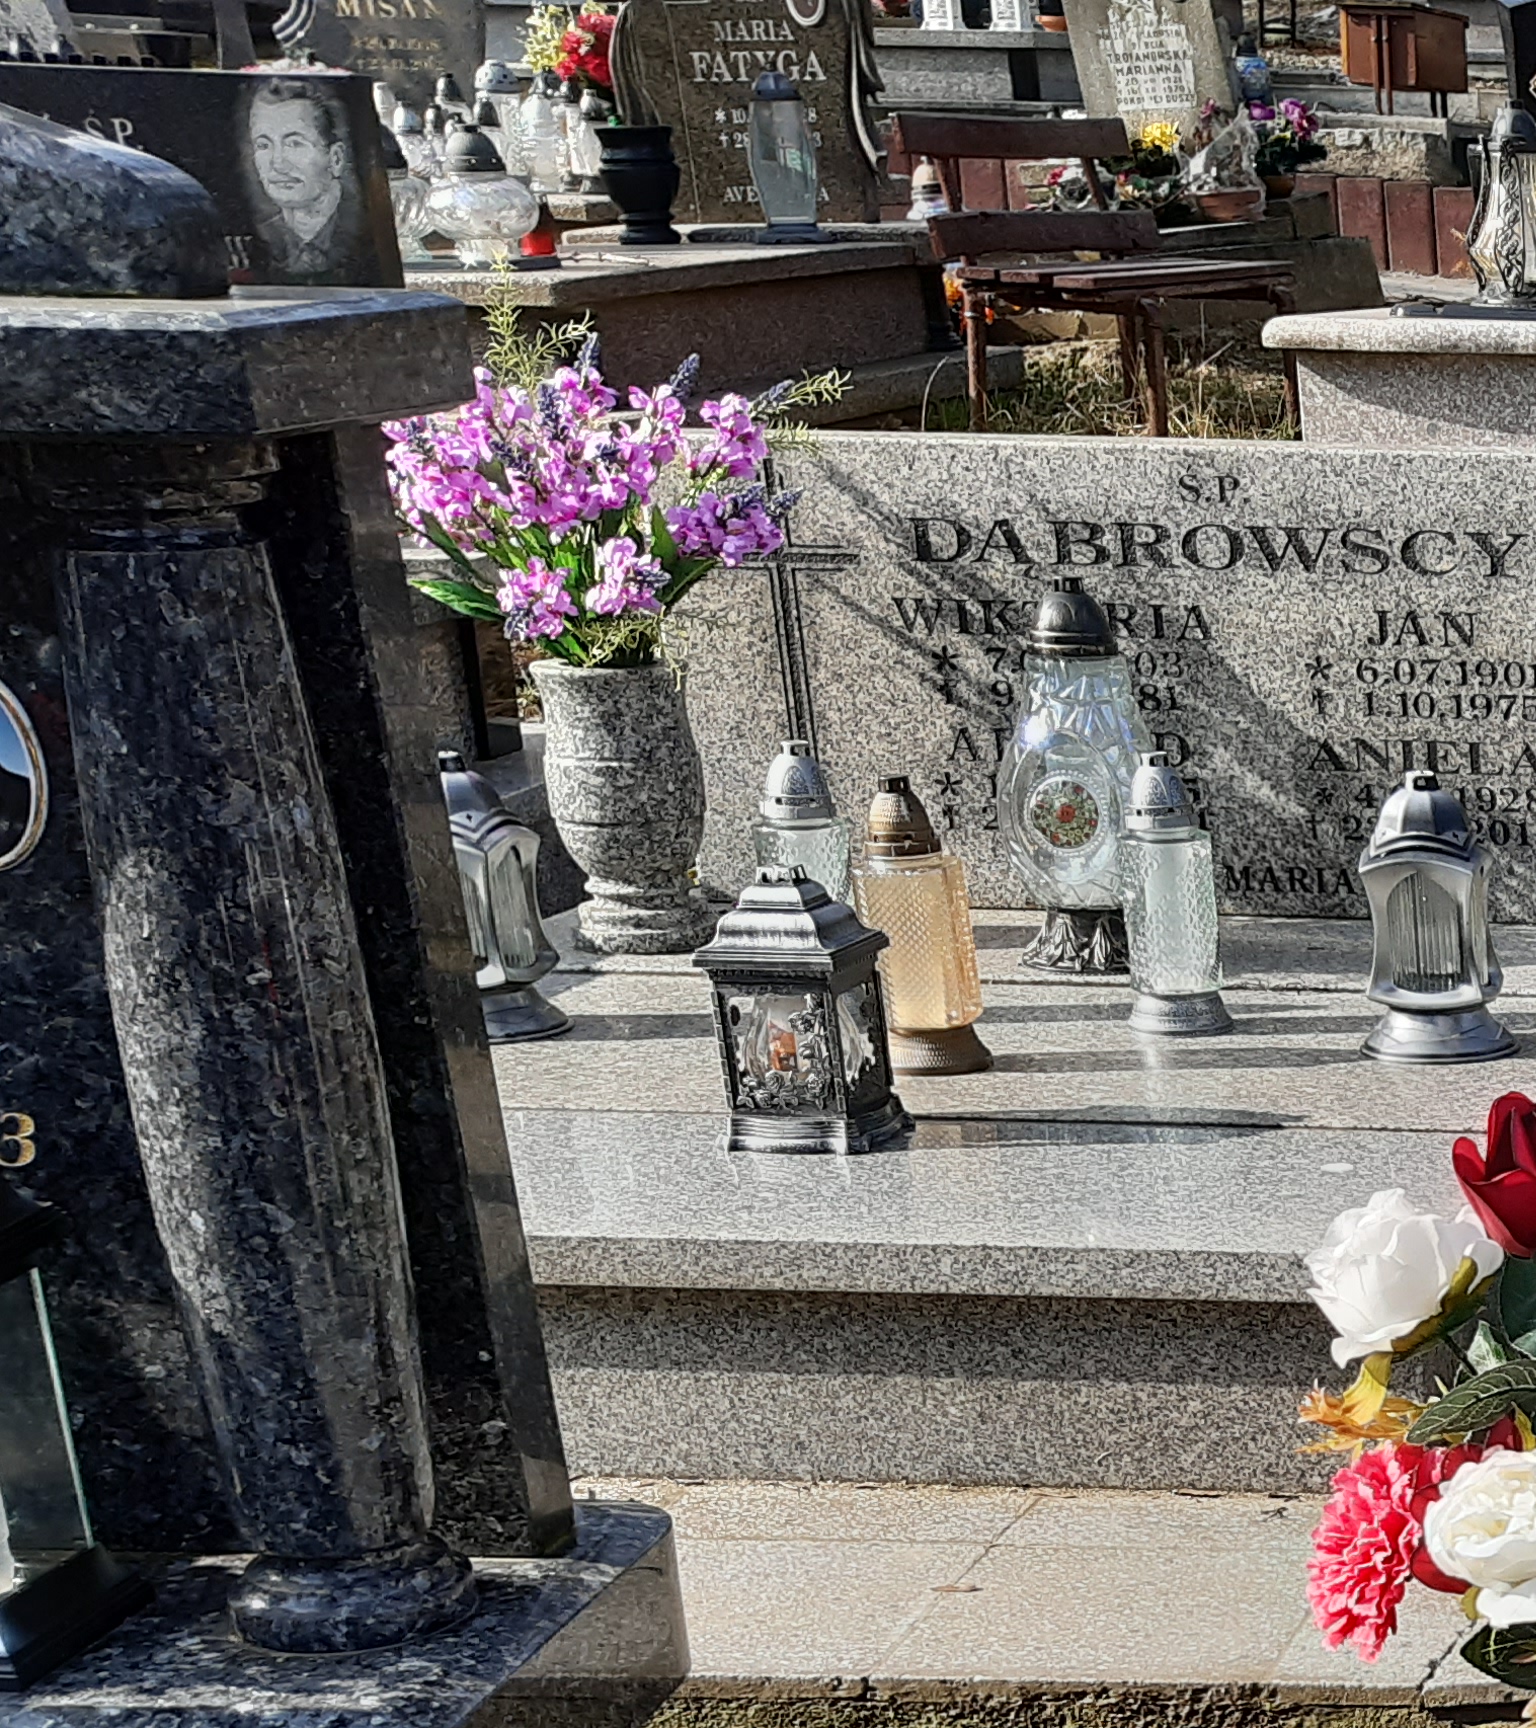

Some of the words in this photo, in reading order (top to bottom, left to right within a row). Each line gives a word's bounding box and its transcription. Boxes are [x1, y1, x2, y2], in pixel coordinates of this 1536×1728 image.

[708, 19, 796, 42] MARIA
[689, 50, 827, 83] FATYGA
[1116, 63, 1182, 77] MARIANNA
[84, 109, 143, 150] ŚP.
[908, 515, 1529, 579] DĄBROWSCY
[894, 598, 1212, 641] WIKRIA
[1367, 610, 1479, 648] JAN
